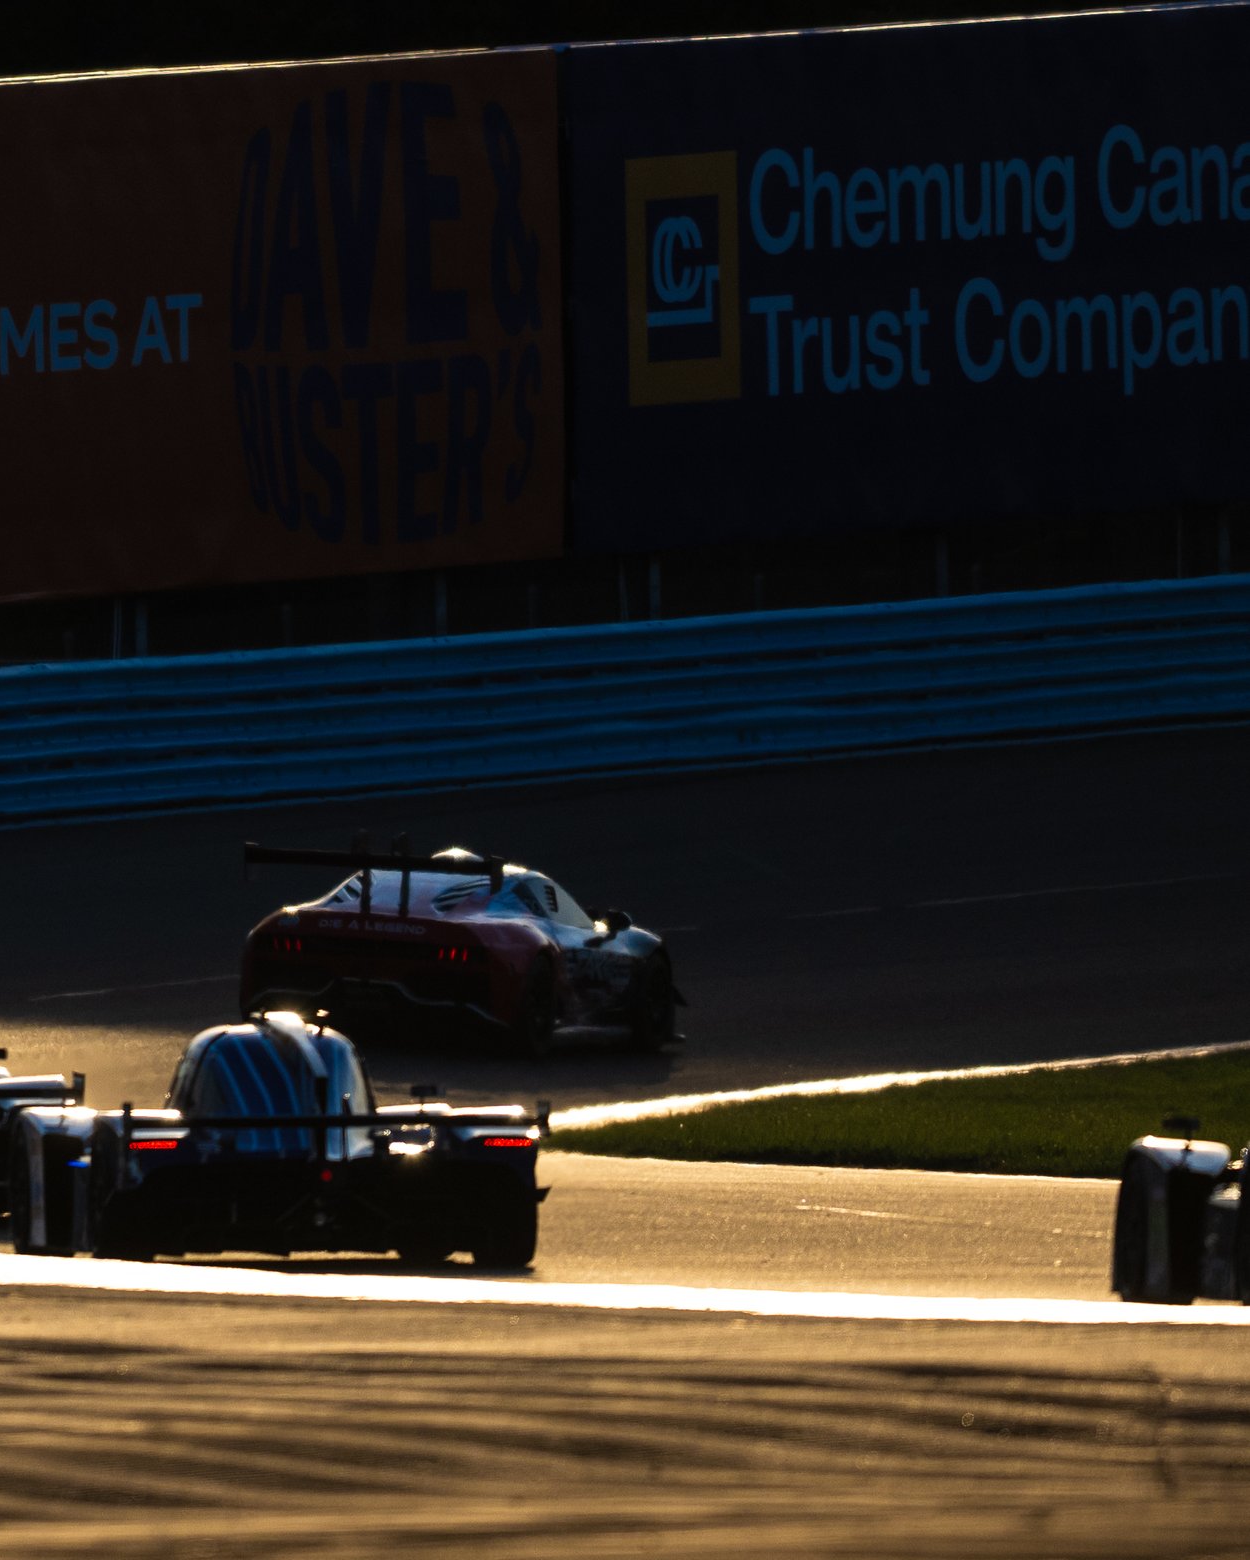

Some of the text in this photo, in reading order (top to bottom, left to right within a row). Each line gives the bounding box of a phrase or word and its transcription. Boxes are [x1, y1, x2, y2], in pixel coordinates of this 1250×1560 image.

[230, 80, 468, 352] DAVE
[482, 101, 543, 337] &
[750, 146, 1076, 263] Chemung
[131, 292, 204, 368] AT
[748, 277, 1250, 397] Trust Compan
[234, 341, 544, 546] BUSTER'S
